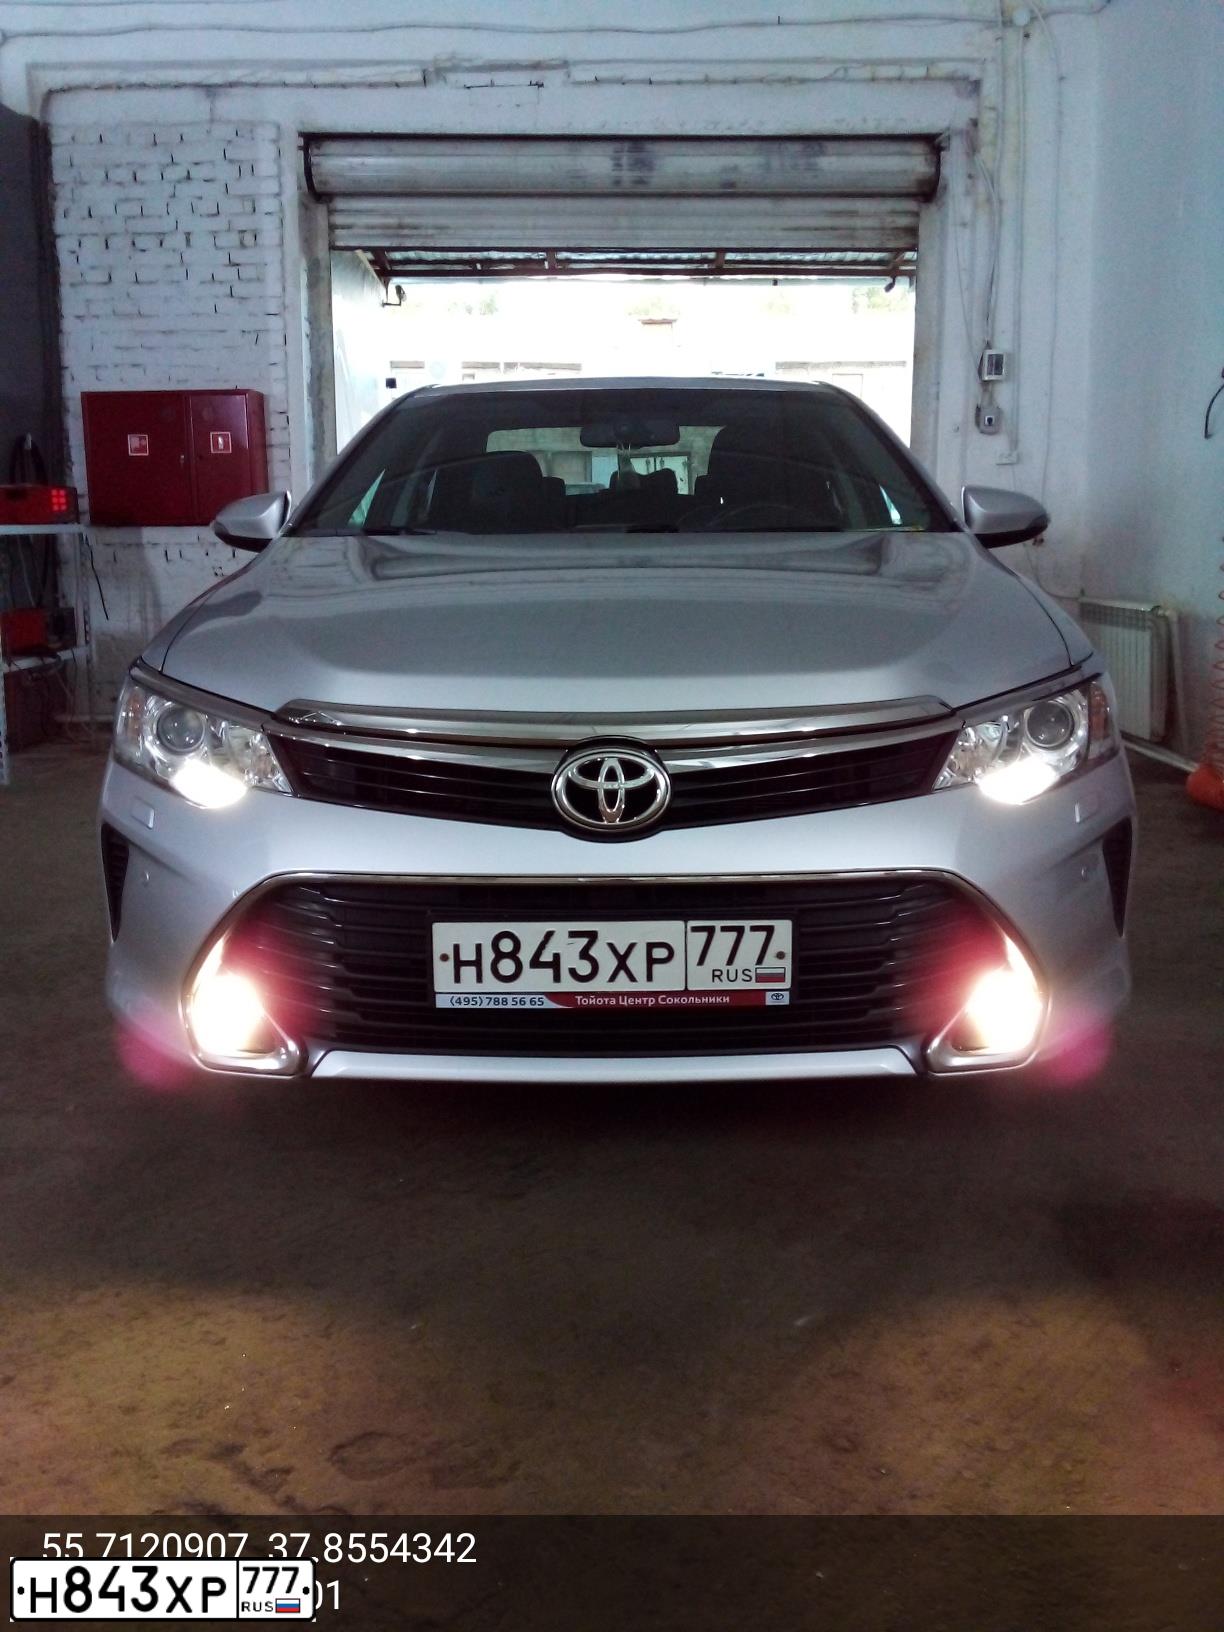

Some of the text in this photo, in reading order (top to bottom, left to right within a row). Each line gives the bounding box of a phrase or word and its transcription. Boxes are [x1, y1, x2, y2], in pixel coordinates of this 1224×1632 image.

[690, 924, 776, 967] 777
[711, 968, 753, 983] RUS
[511, 996, 527, 1007] 56
[529, 996, 545, 1007] 65
[575, 994, 730, 1008] Тойота Центр Сокольники
